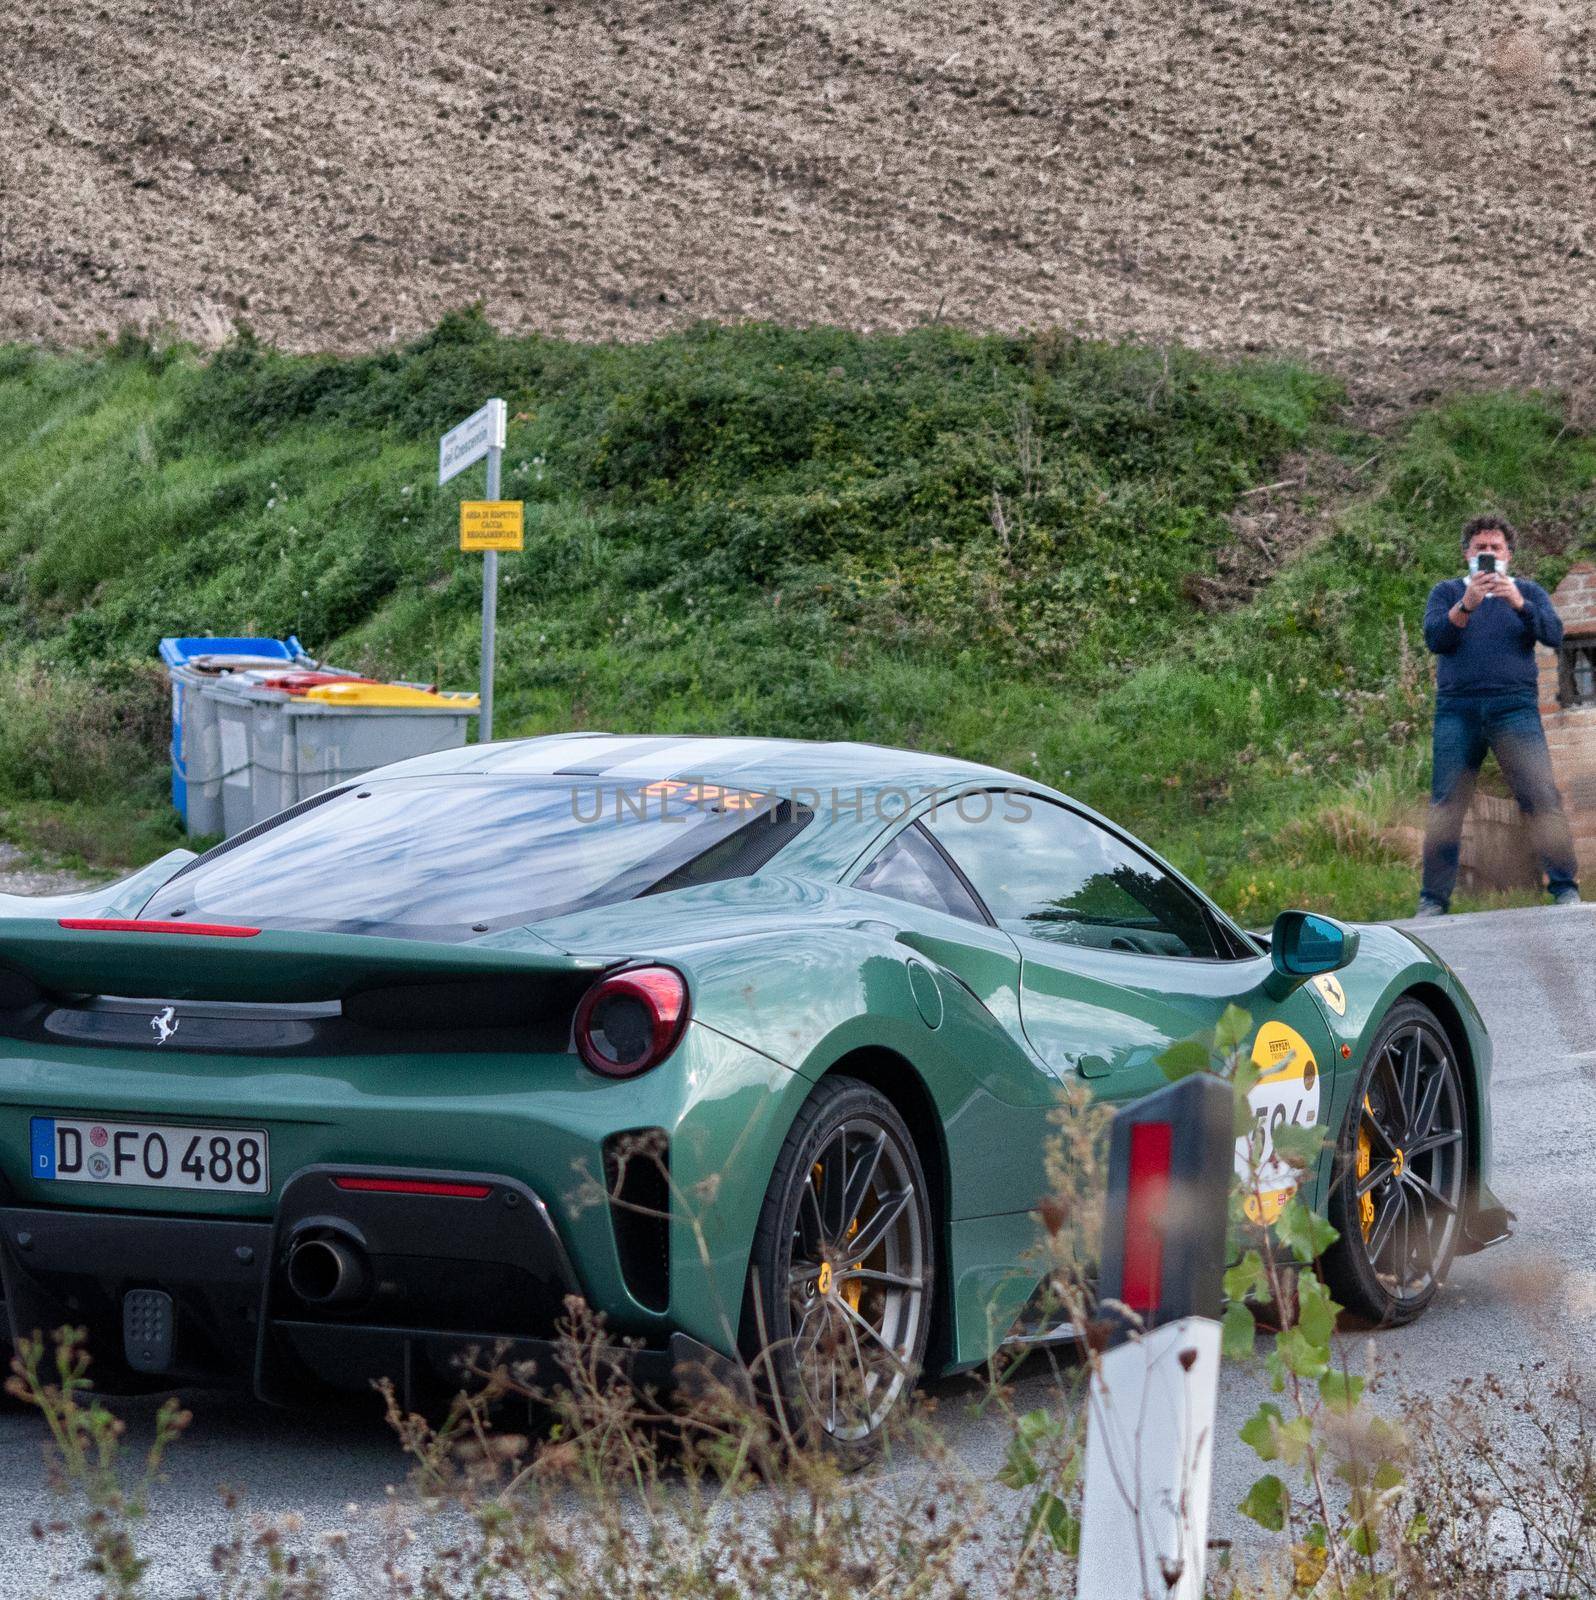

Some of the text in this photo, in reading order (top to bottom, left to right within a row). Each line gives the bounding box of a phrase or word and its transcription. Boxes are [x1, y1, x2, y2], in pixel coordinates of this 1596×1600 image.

[481, 520, 503, 528] CACCIA
[39, 1155, 48, 1168] D
[57, 1127, 261, 1184] D FO 488
